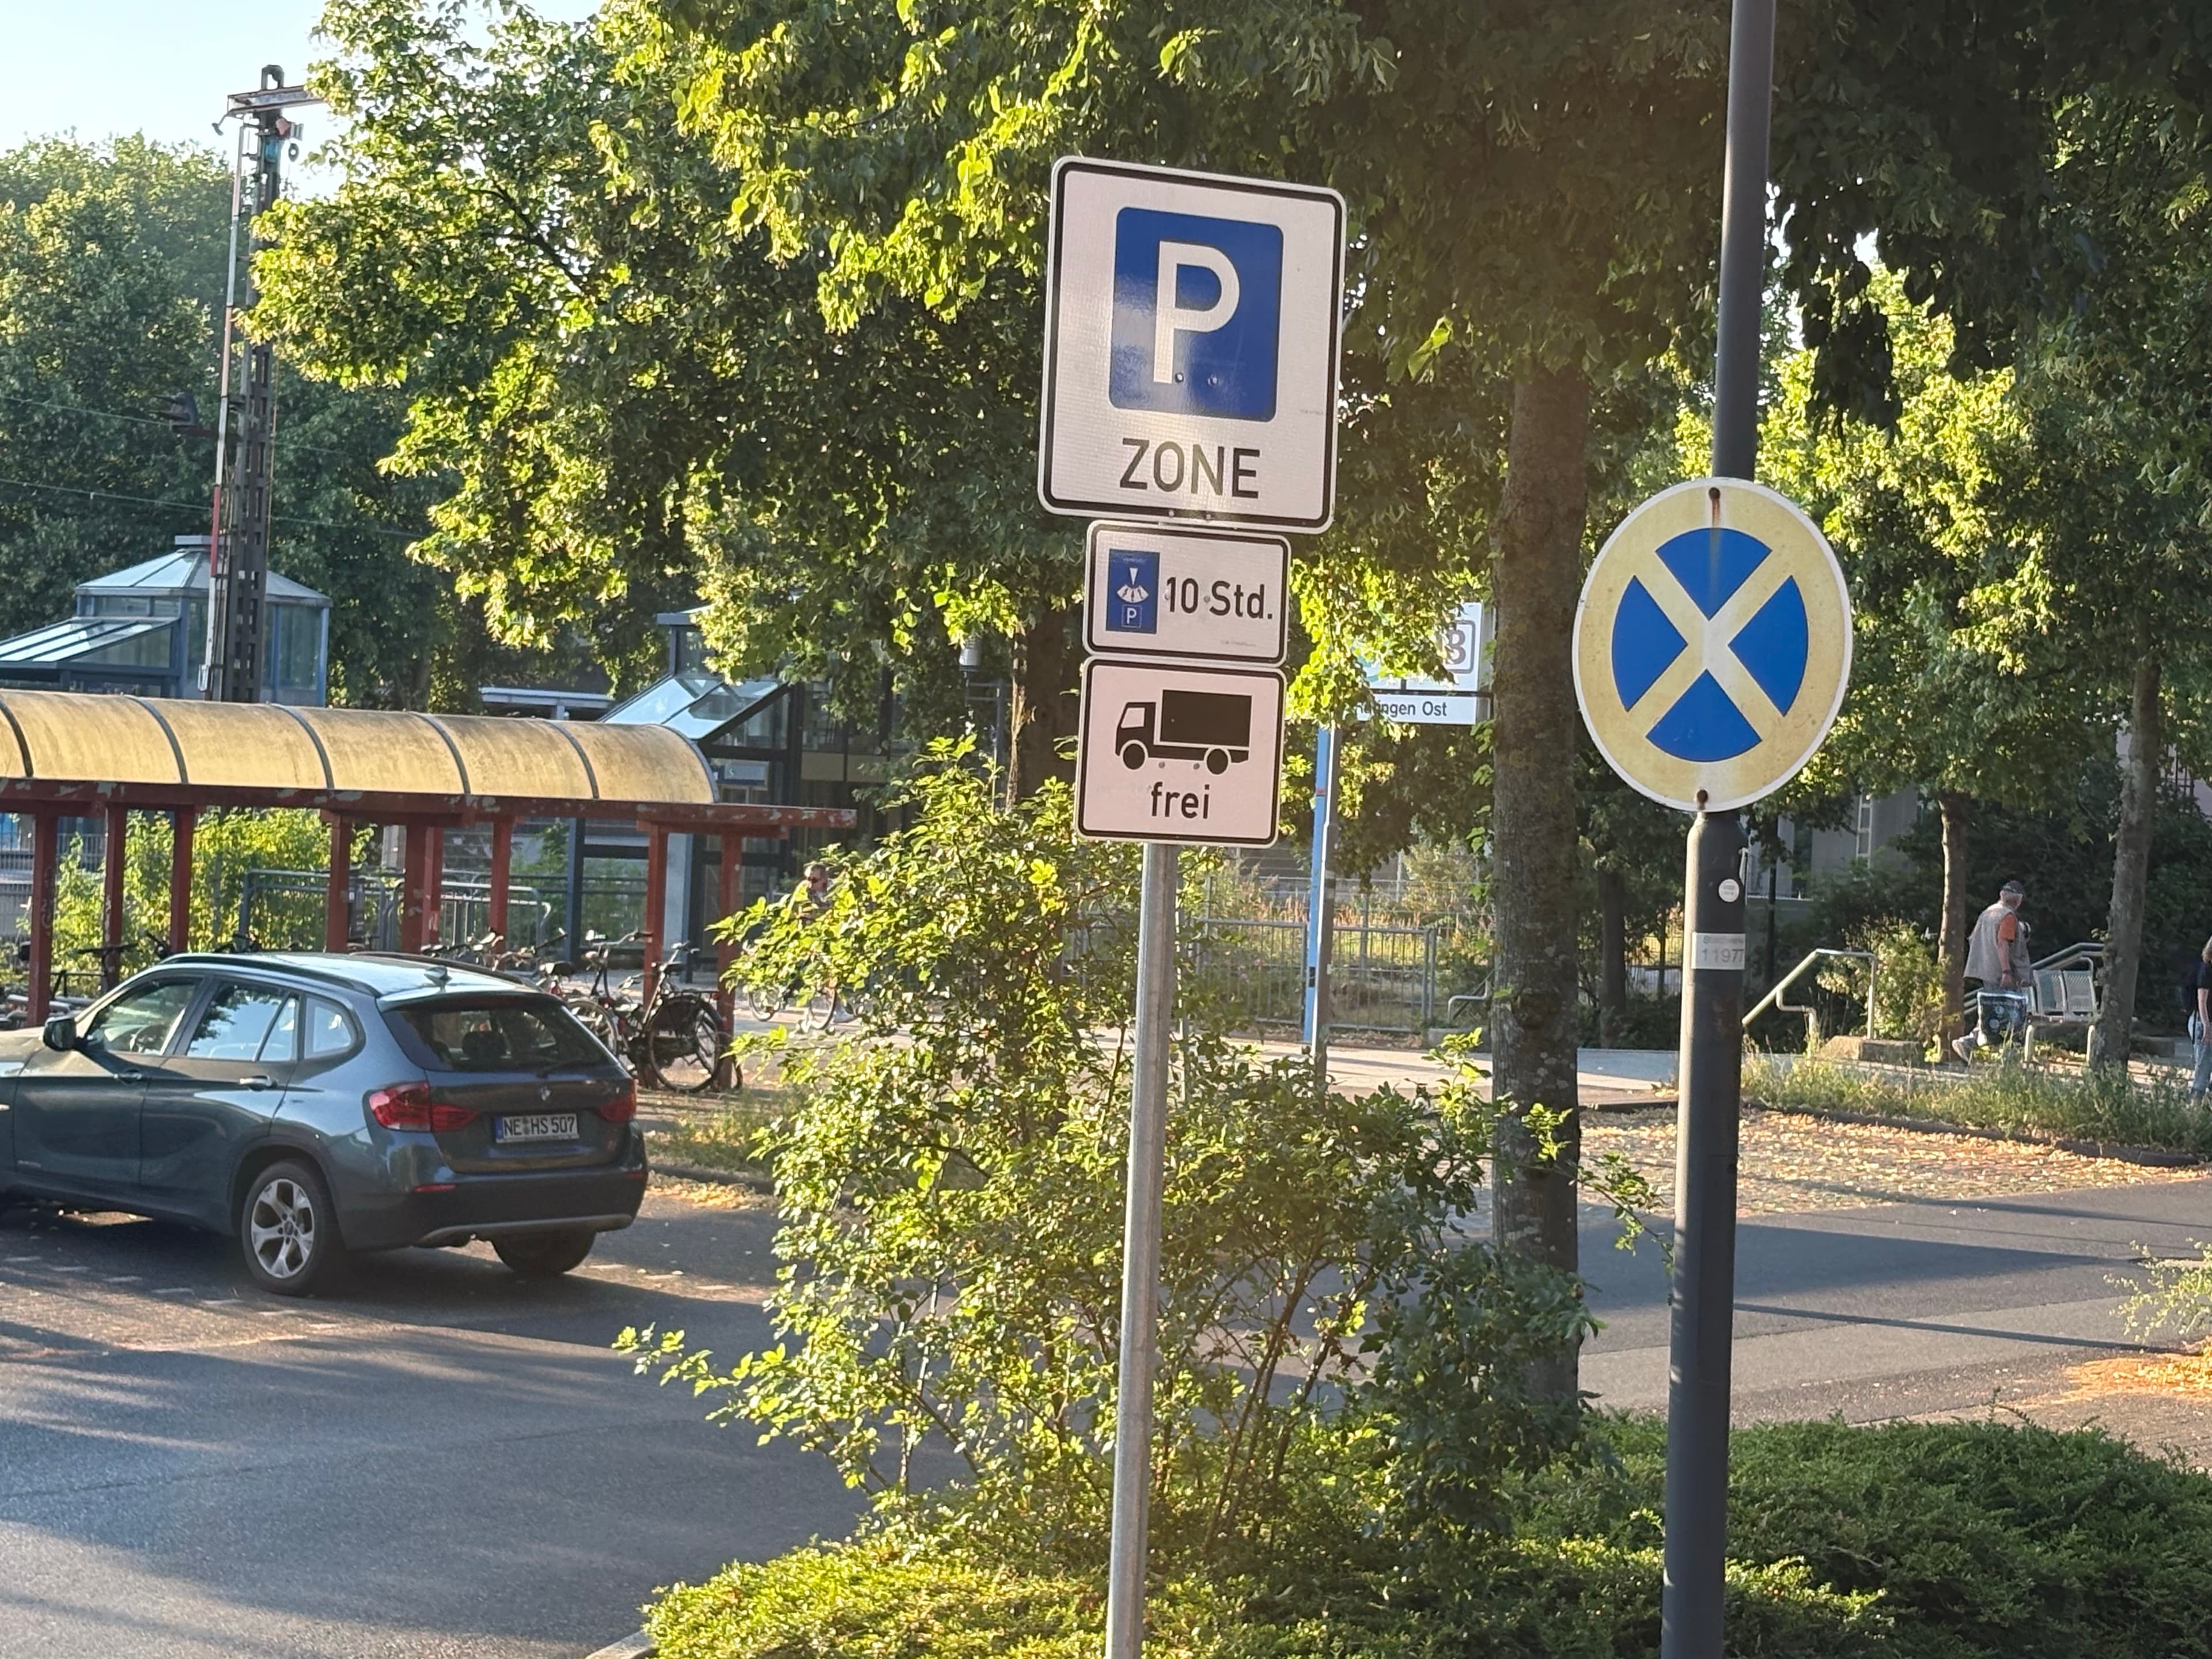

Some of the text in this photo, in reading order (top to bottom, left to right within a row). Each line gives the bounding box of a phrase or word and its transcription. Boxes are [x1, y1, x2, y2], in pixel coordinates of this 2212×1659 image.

[1153, 240, 1240, 384] P
[1119, 437, 1261, 499] ZONE
[1126, 607, 1137, 624] P
[1166, 577, 1274, 620] 10 Std.
[1422, 700, 1447, 717] Ost
[1151, 781, 1210, 820] frei
[503, 1115, 575, 1136] NE HS 507
